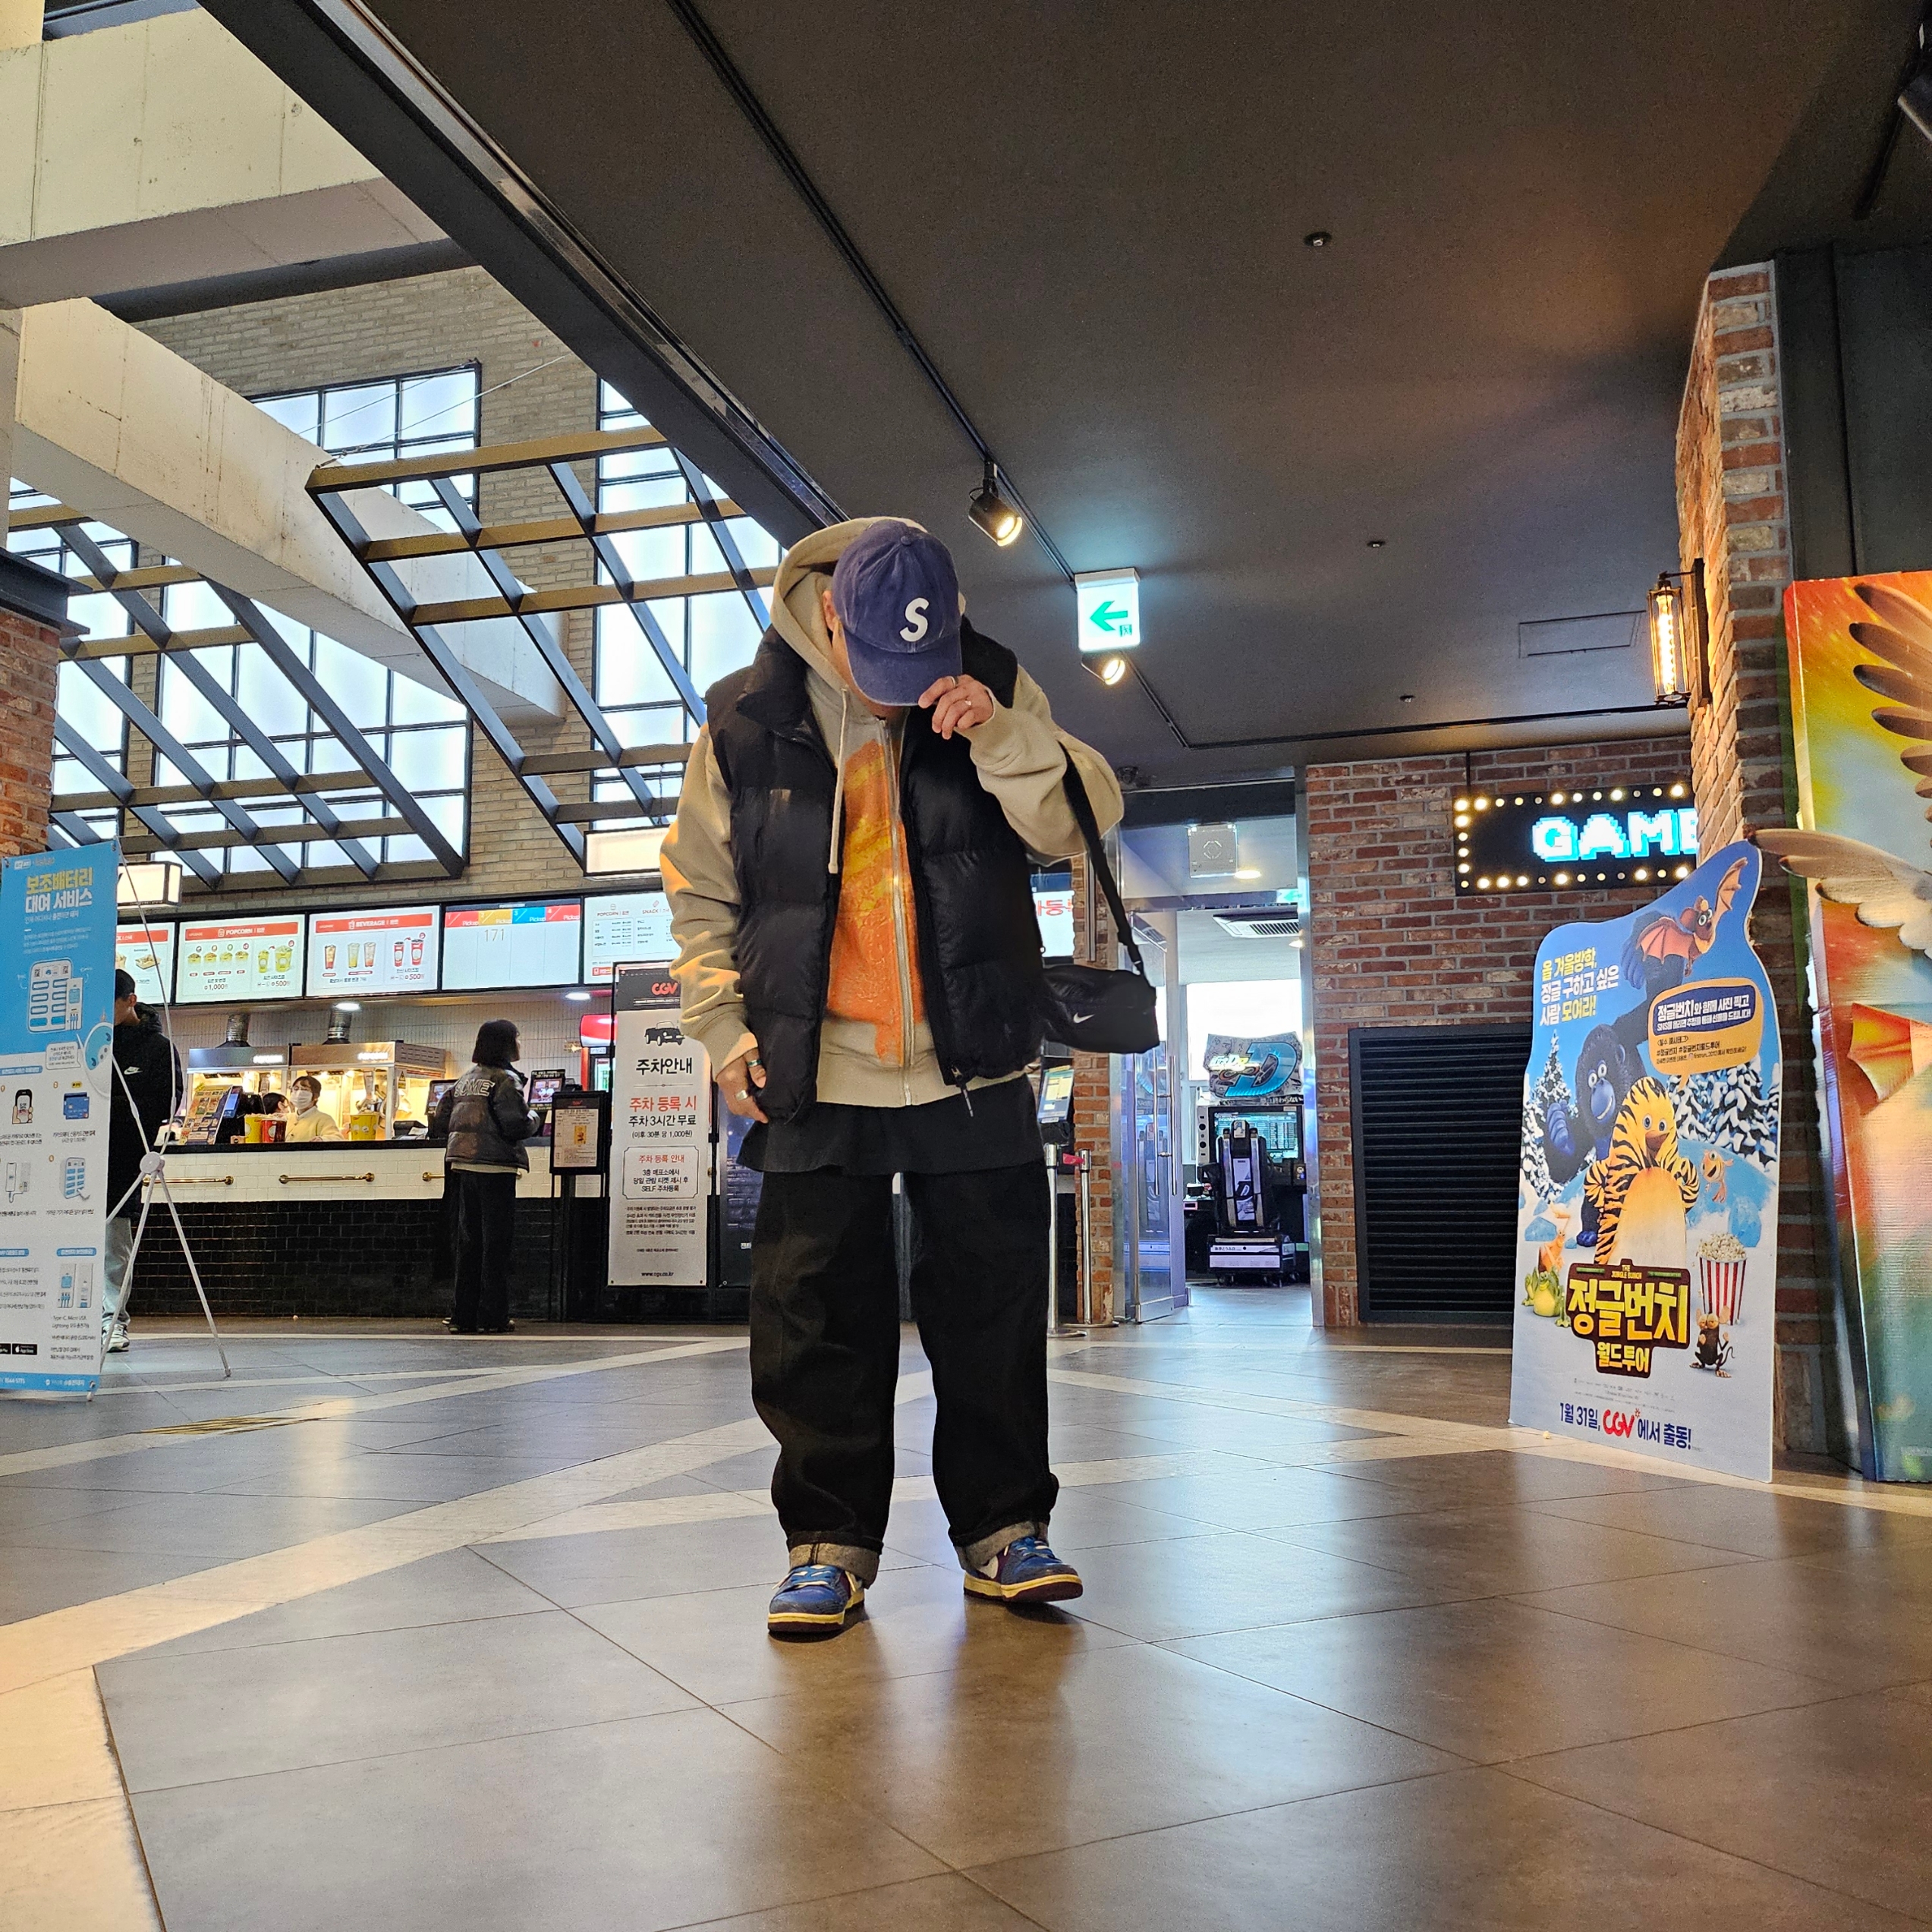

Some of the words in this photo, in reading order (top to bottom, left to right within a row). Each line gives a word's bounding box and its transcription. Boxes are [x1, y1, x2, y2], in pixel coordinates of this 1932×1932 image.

[900, 597, 930, 642] S
[27, 867, 93, 895] 보조배터리
[25, 893, 51, 914] 대여
[53, 888, 93, 909] 서비스
[226, 927, 253, 936] POPCORN
[484, 928, 505, 942] 171
[1541, 960, 1552, 982] 올
[1554, 947, 1597, 978] 겨울방학,
[651, 982, 678, 996] CGV
[1541, 980, 1561, 1004] 정글
[1562, 972, 1594, 999] 구하고
[1596, 964, 1619, 991] 싶은
[1540, 1004, 1560, 1026] 사람
[1657, 999, 1702, 1022] 정글번치와
[1702, 999, 1717, 1015] 함께
[1718, 996, 1733, 1012] 사진
[1734, 994, 1750, 1008] 찍고
[636, 1057, 693, 1075] 주차안내
[629, 1097, 654, 1112] 주차
[657, 1096, 681, 1112] 등록
[684, 1095, 697, 1111] 시
[628, 1115, 648, 1127] 주차
[650, 1115, 675, 1127] 3시간
[677, 1115, 697, 1126] 무료
[639, 1155, 653, 1163] 주차
[655, 1155, 669, 1163] 등록
[671, 1154, 684, 1163] 안내
[1568, 1278, 1689, 1343] 정글번치
[1597, 1342, 1650, 1373] 월드투어
[1560, 1402, 1574, 1424] 1월
[1576, 1405, 1600, 1431] 31일,
[1603, 1409, 1635, 1439] CGV
[1638, 1418, 1660, 1443] 에서
[1663, 1423, 1691, 1450] 출동!
